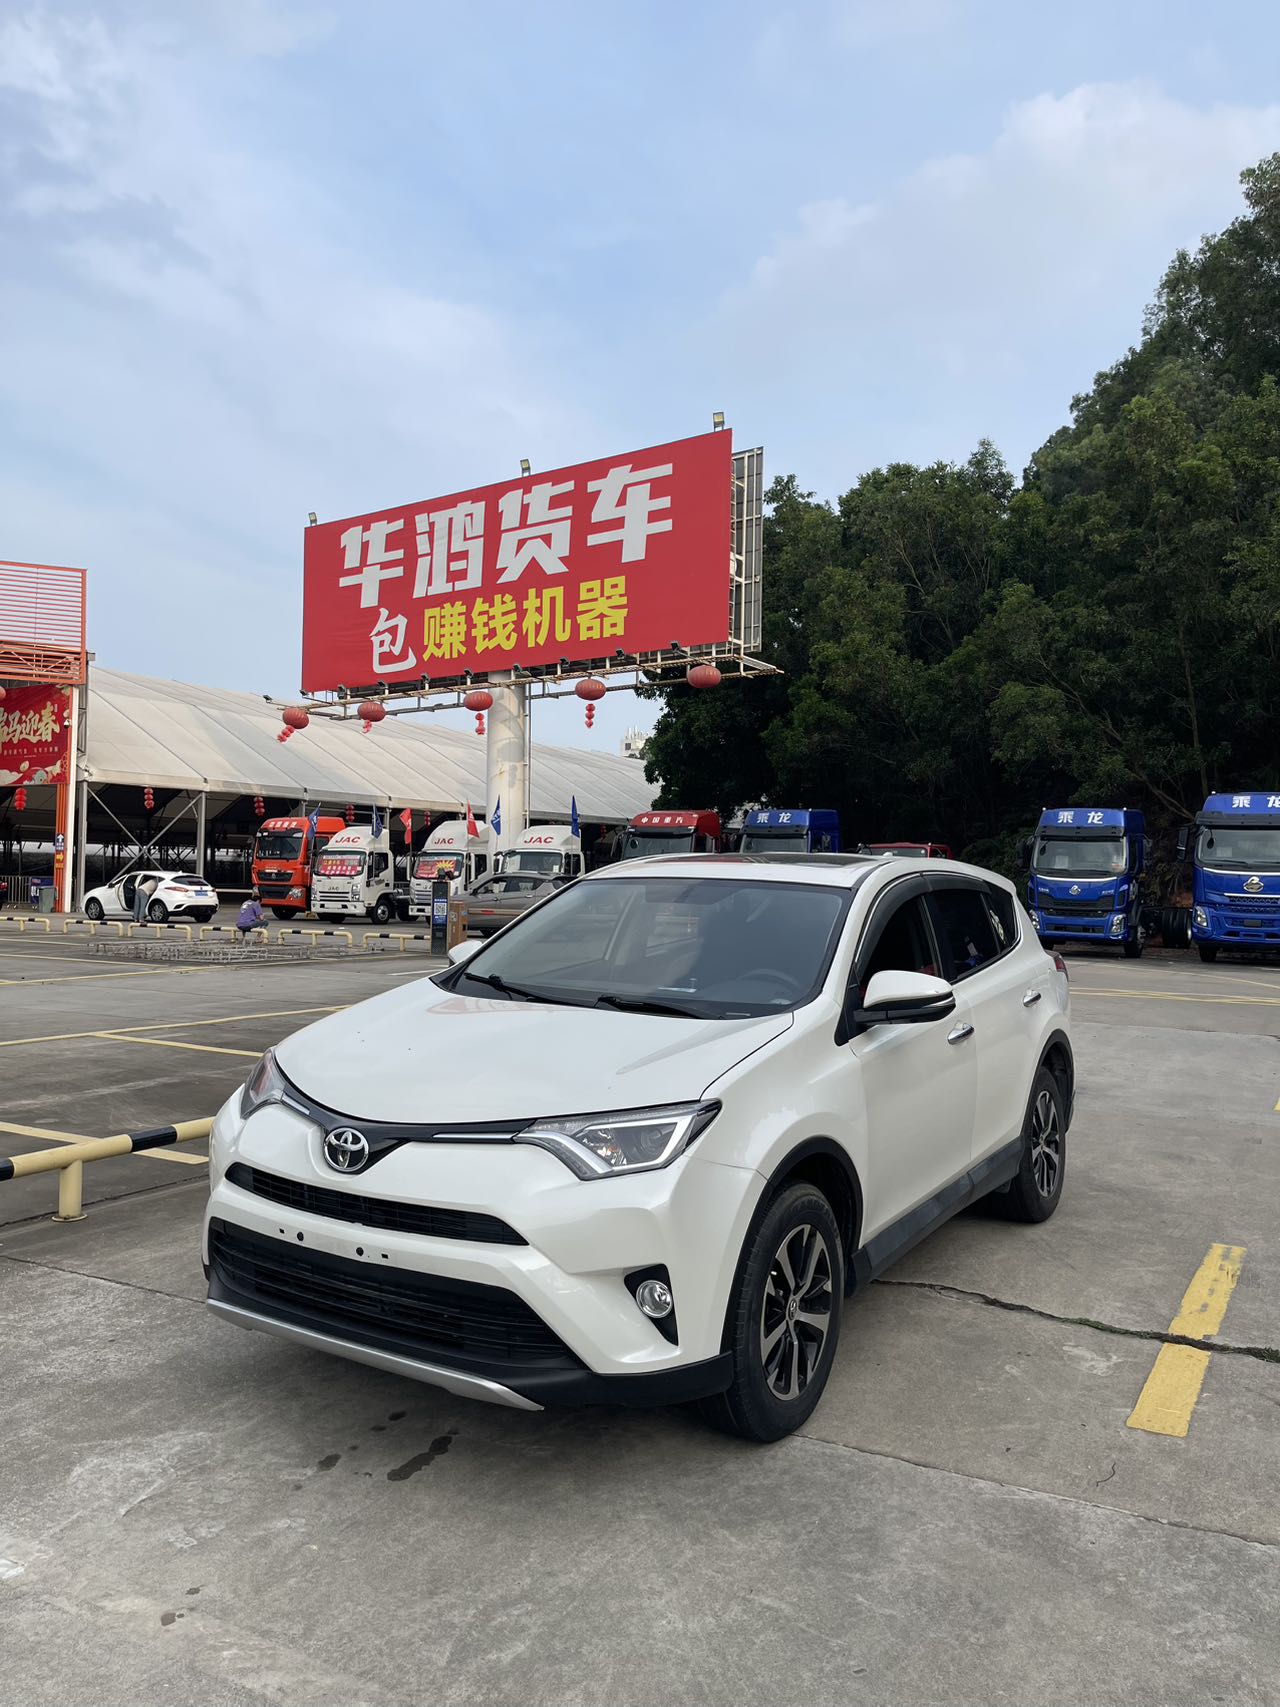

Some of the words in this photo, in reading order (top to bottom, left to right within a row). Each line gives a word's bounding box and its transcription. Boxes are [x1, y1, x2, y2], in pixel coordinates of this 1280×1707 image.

[339, 463, 673, 608] 华鸿货车
[369, 575, 629, 674] 包赚钱机器
[641, 816, 683, 825] 中国重汽
[756, 812, 792, 824] 乘龙
[1057, 811, 1104, 824] 乘龙
[335, 836, 361, 844] JAC
[434, 837, 454, 845] JAC
[523, 836, 554, 844] JAC
